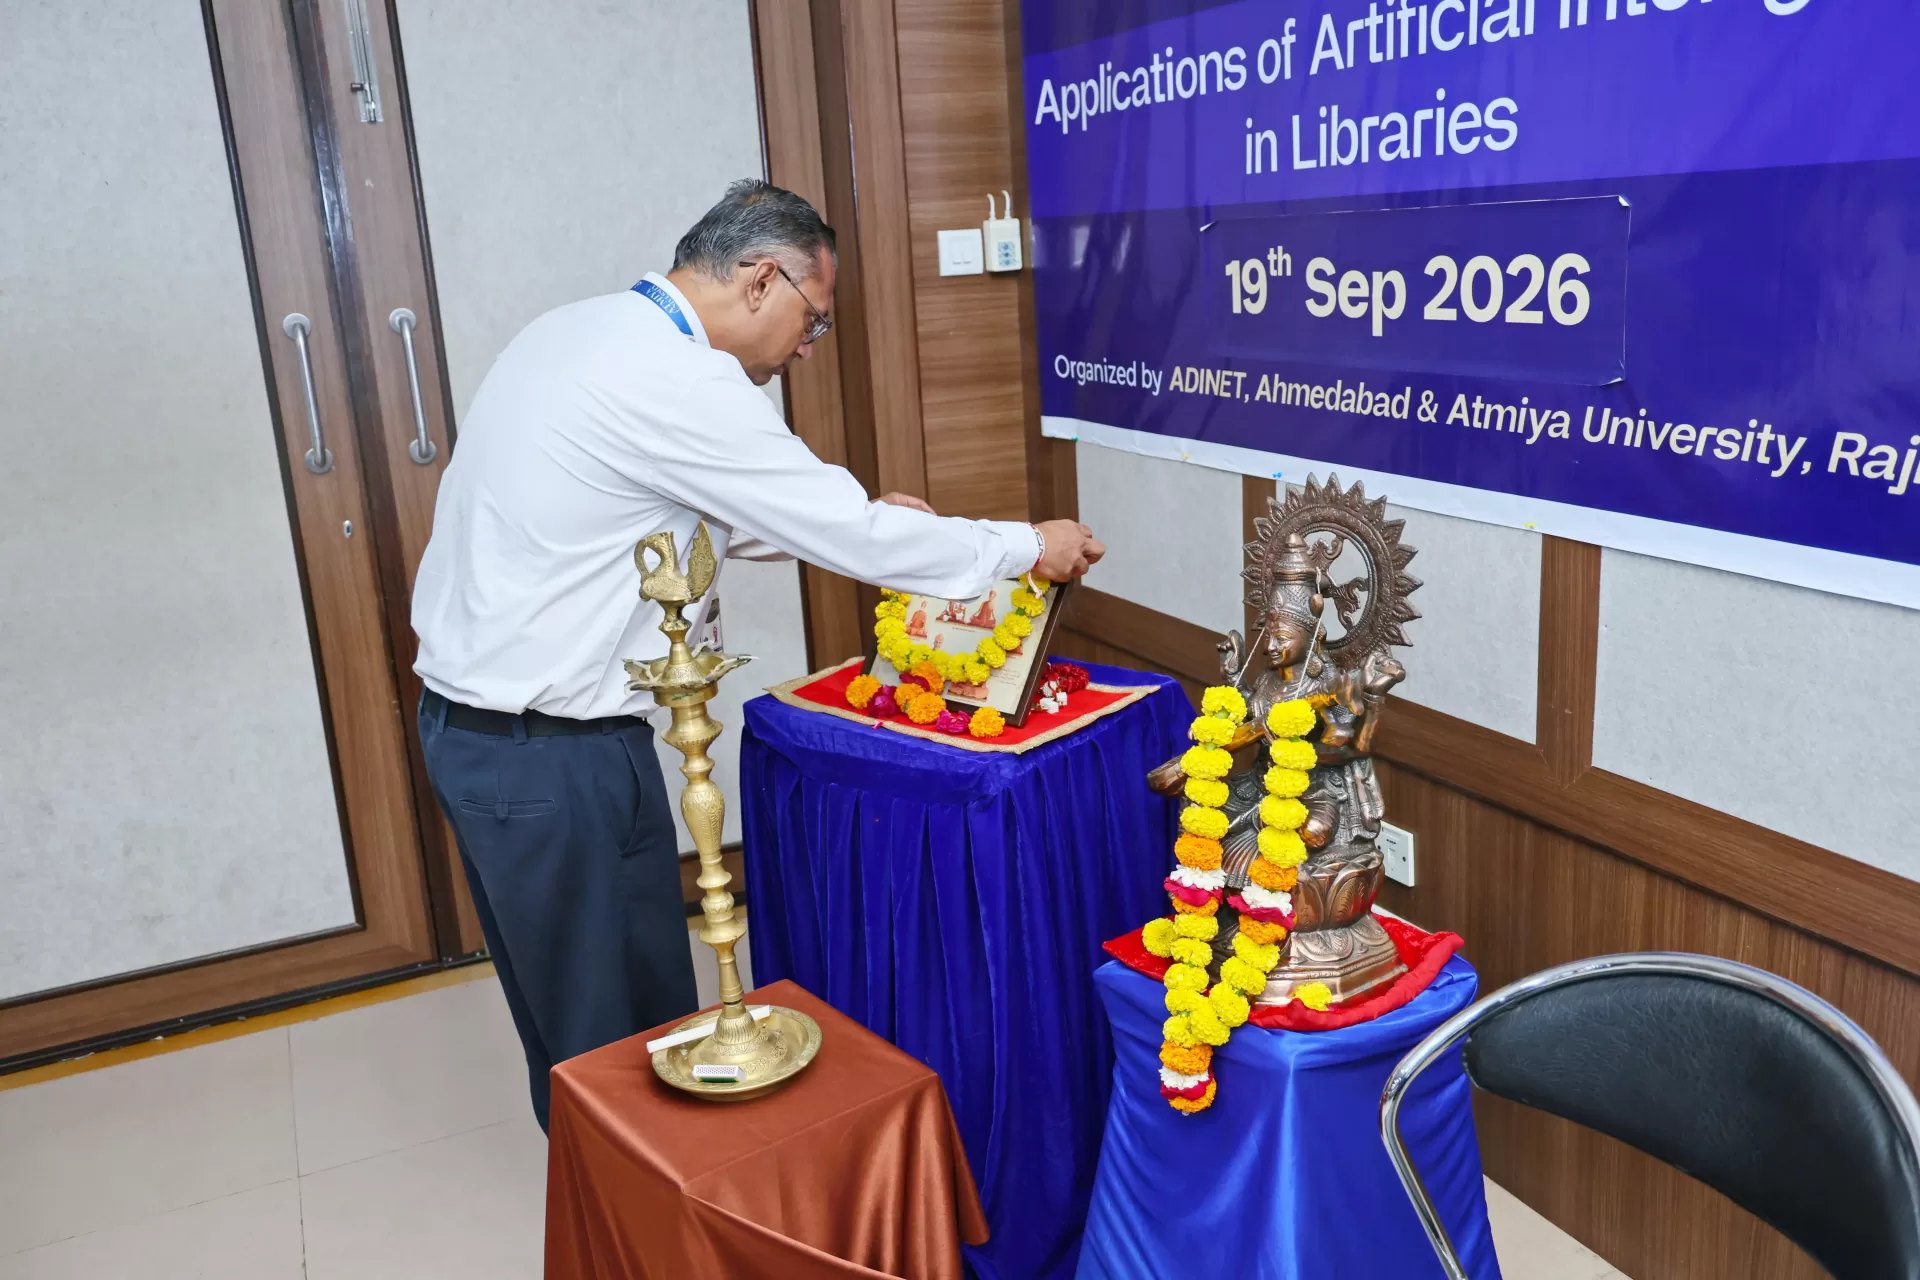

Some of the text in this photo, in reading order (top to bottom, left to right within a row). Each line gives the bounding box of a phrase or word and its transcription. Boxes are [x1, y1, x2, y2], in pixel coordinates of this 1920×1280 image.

[1035, 47, 1247, 134] Applications
[1257, 17, 1297, 84] of
[1245, 87, 1519, 175] in Libraries
[646, 288, 675, 314] ATMIYA
[1225, 246, 1591, 337] 19th Sep 2026
[1054, 354, 1920, 495] Organized by ADINET, Ahmedabad & Atmiya University, Raj
